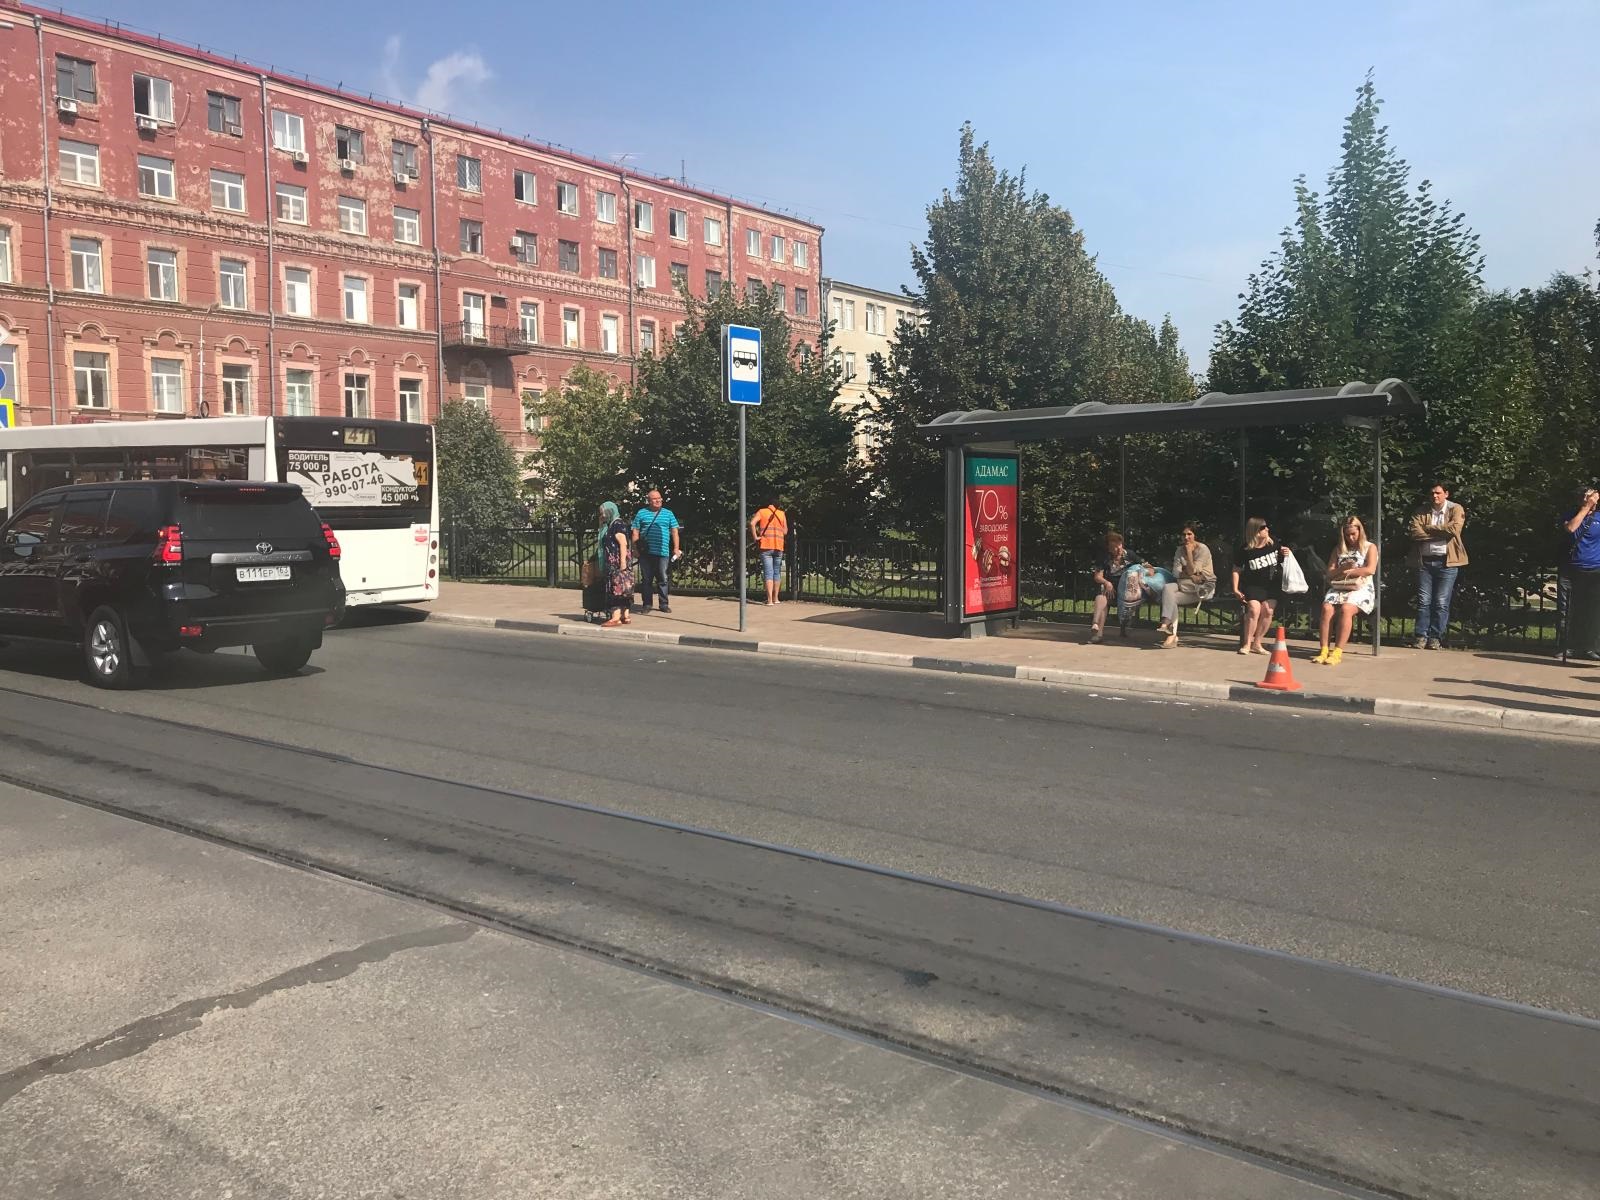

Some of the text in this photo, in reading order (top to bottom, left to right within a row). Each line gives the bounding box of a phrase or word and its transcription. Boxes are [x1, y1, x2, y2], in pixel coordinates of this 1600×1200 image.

[288, 453, 329, 462] ВОДИТЕЛЬ
[289, 461, 301, 471] 75
[303, 461, 320, 471] 000
[416, 465, 428, 481] 41
[975, 465, 1009, 477] АДАМАС
[322, 461, 380, 486] РАБОТА
[325, 474, 384, 498] 990-07-46
[381, 493, 393, 502] 45
[394, 493, 409, 502] 000
[975, 489, 1009, 529] 70%
